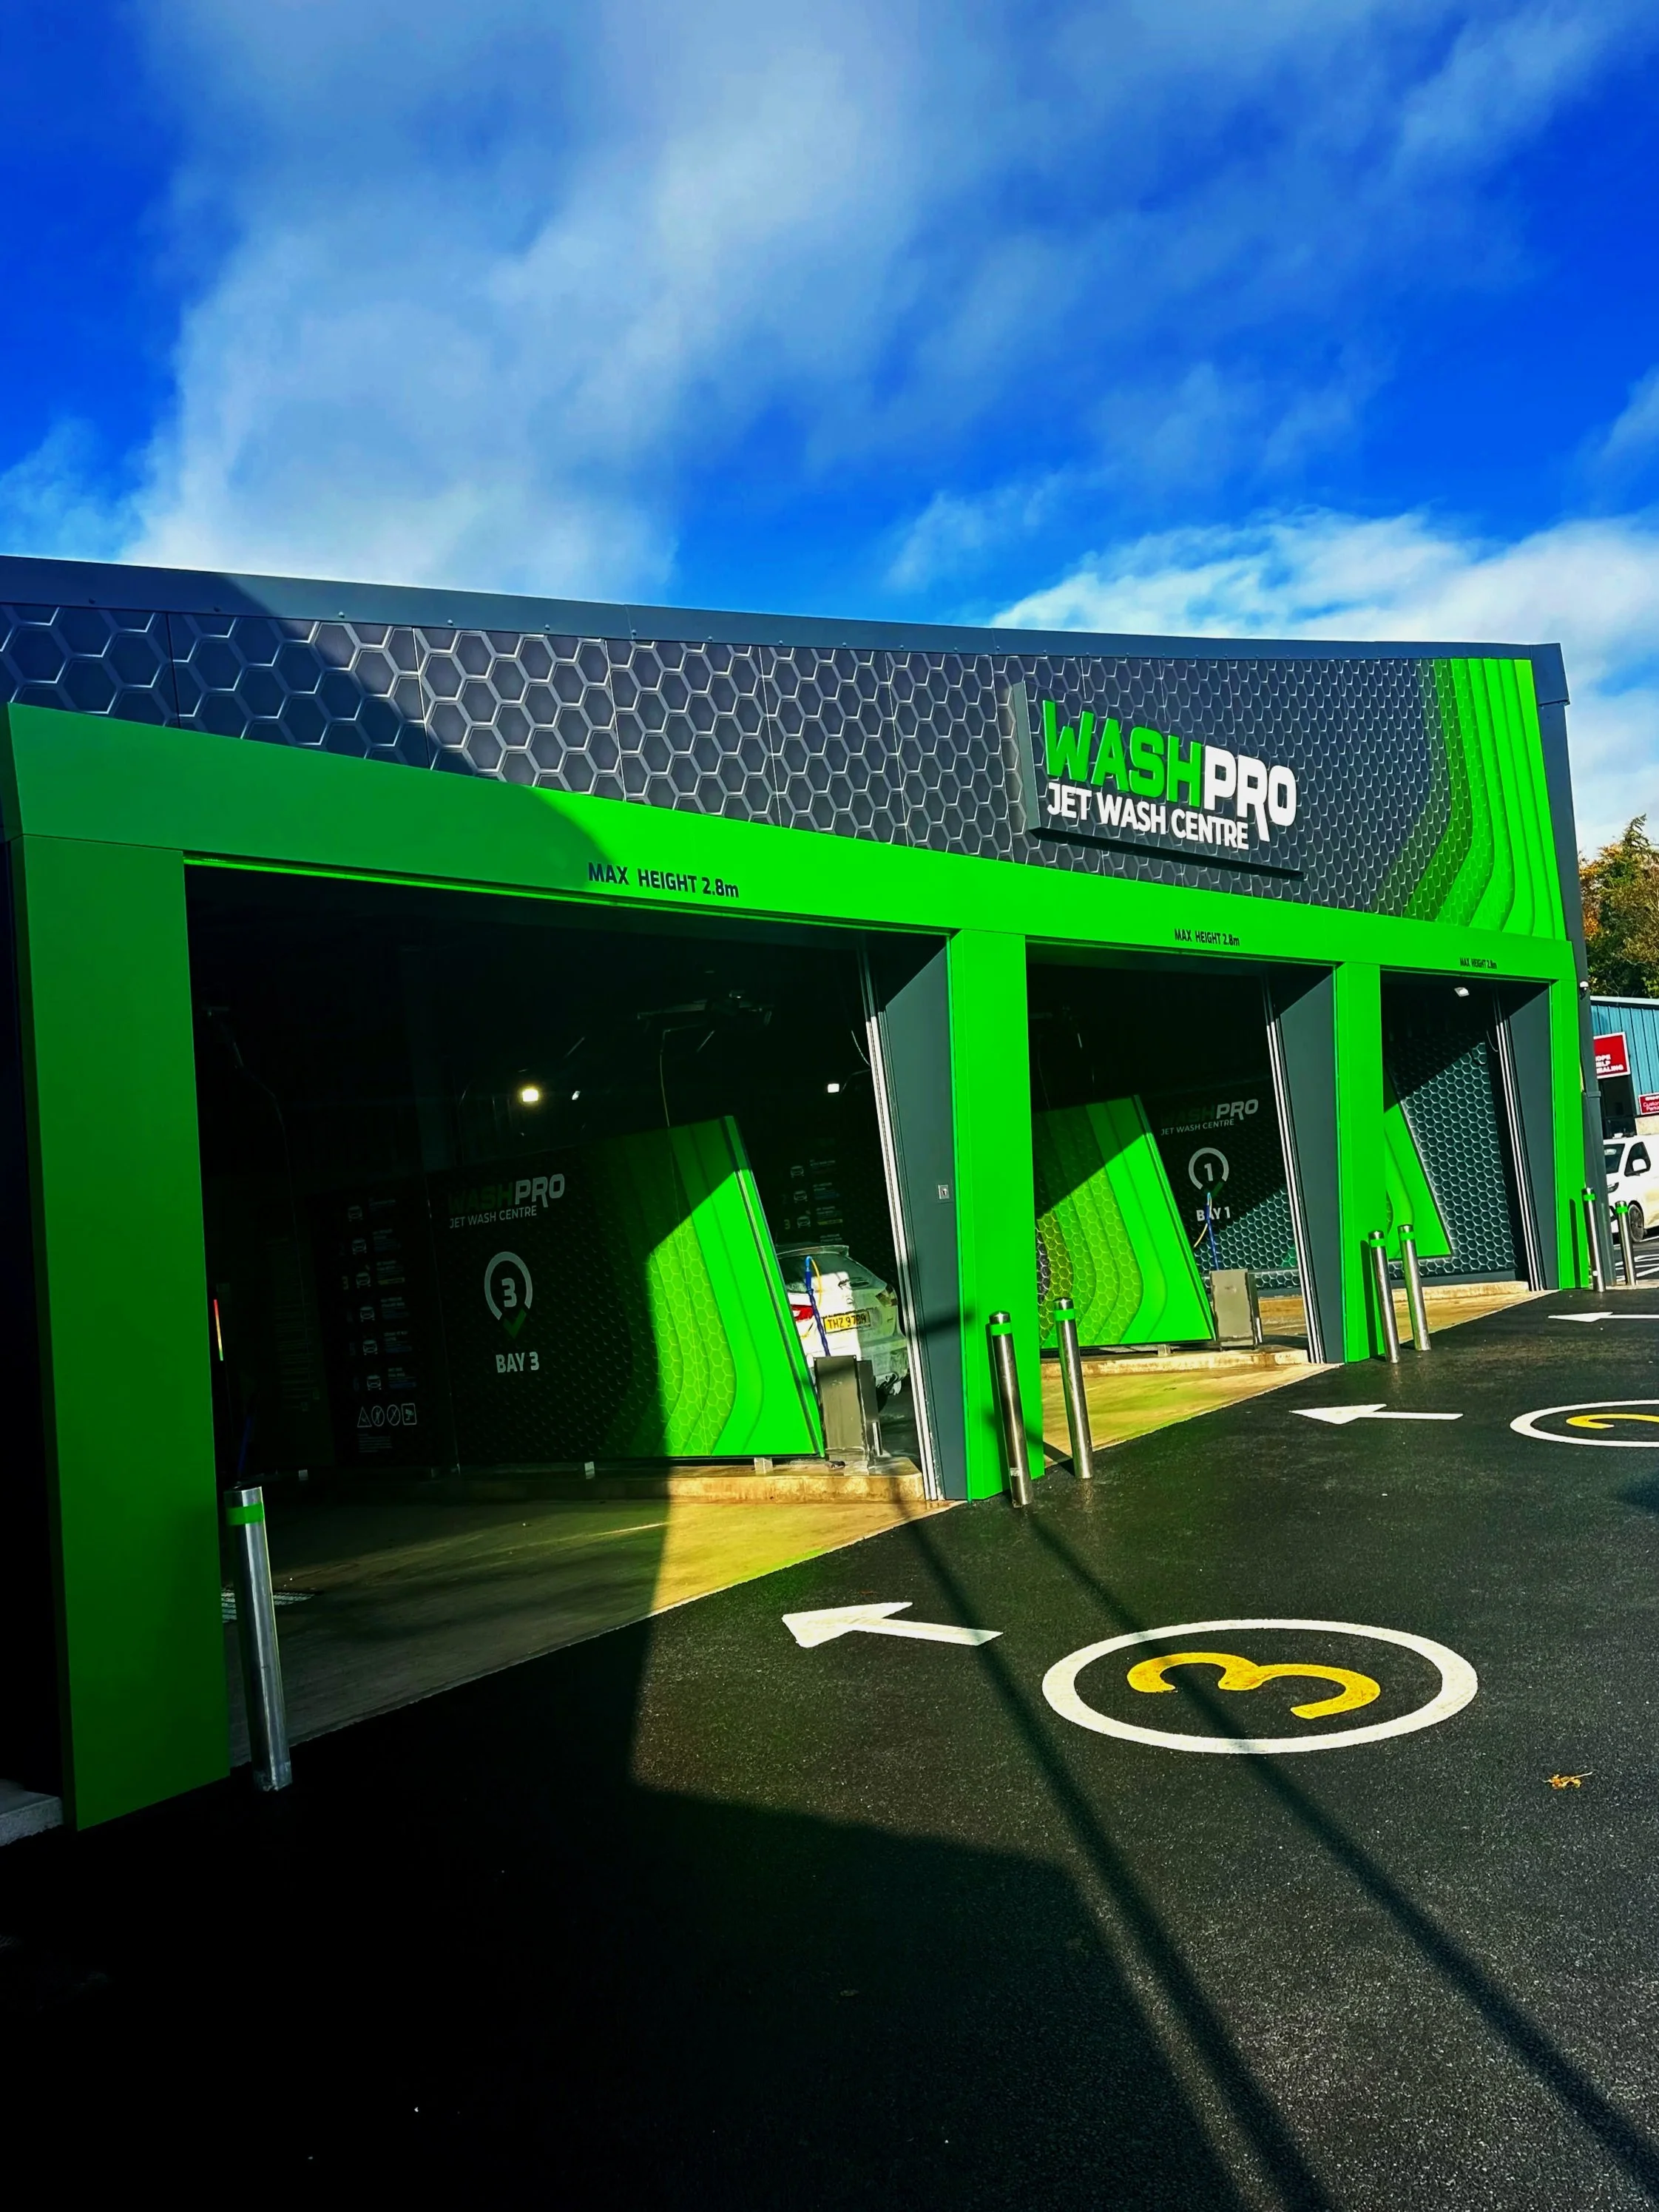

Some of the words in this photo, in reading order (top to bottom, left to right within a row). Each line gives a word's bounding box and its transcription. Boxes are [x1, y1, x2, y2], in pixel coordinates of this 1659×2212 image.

[1042, 699, 1297, 842] WASHPRO
[1047, 782, 1093, 820] JET
[1097, 792, 1166, 835] WASH
[1171, 808, 1250, 850] CENTRE
[588, 862, 629, 886] MAX
[637, 868, 697, 893] HEIGHT
[701, 877, 739, 898] 2.8m
[1174, 928, 1192, 942] MAX
[1195, 931, 1221, 945] HEIGHT
[1222, 933, 1240, 946] 2.8m
[1160, 1127, 1175, 1136] JET
[1176, 1124, 1200, 1134] WASH
[1202, 1119, 1235, 1130] CENTRE
[1203, 1162, 1214, 1181] 1
[449, 1216, 466, 1230] JET
[467, 1211, 497, 1226] WASH
[499, 1204, 538, 1221] CENTRE
[1224, 1206, 1231, 1219] 1
[501, 1277, 517, 1307] 3
[495, 1352, 525, 1374] BAY
[529, 1351, 540, 1371] 3
[1126, 1653, 1380, 1720] 3
